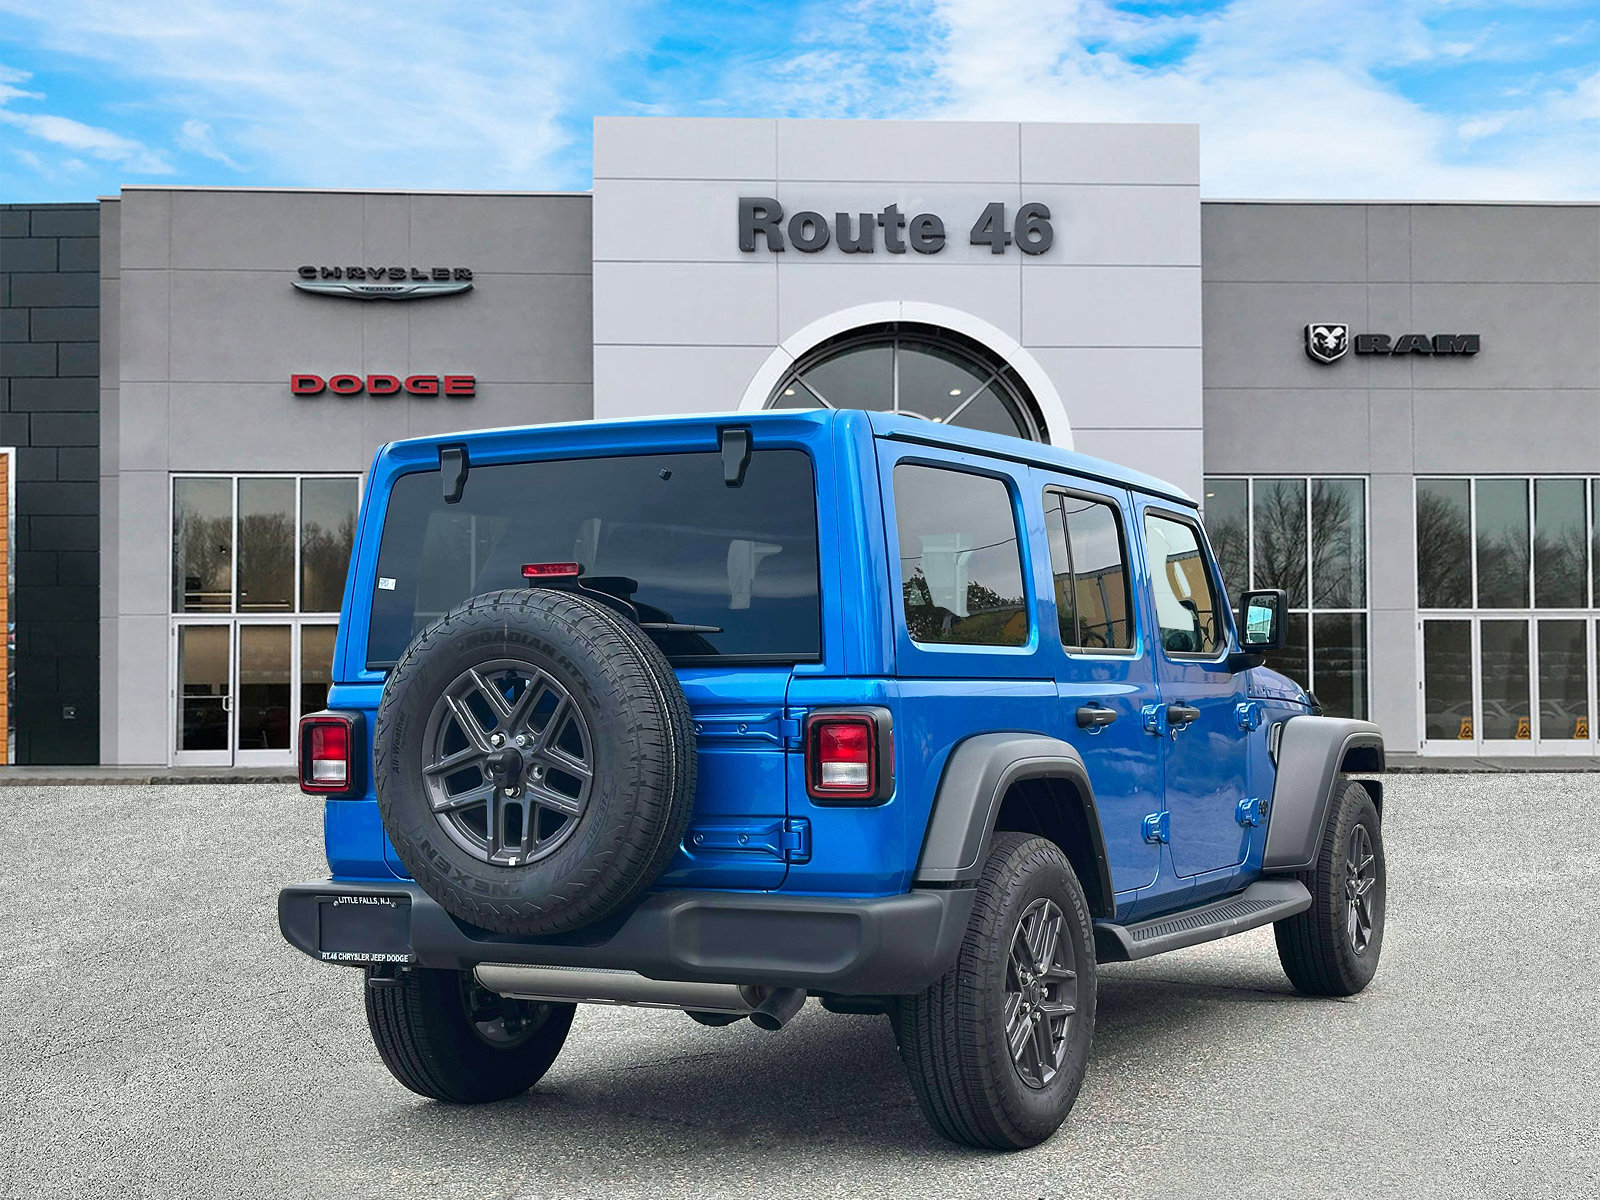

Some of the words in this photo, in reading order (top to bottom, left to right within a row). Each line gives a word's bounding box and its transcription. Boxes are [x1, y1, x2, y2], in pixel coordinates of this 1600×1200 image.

[738, 197, 946, 255] Route
[969, 202, 1054, 255] 46
[297, 265, 473, 281] CHRYSLER
[1354, 333, 1481, 356] RAM
[290, 373, 476, 397] DODGE
[419, 838, 511, 897] NEXEN
[338, 896, 359, 904] LITTLE
[359, 897, 380, 906] FALLS,
[380, 897, 391, 905] N.J.
[338, 953, 370, 961] CHRYSLER
[370, 954, 386, 962] JEEP
[386, 954, 409, 963] DODGE
